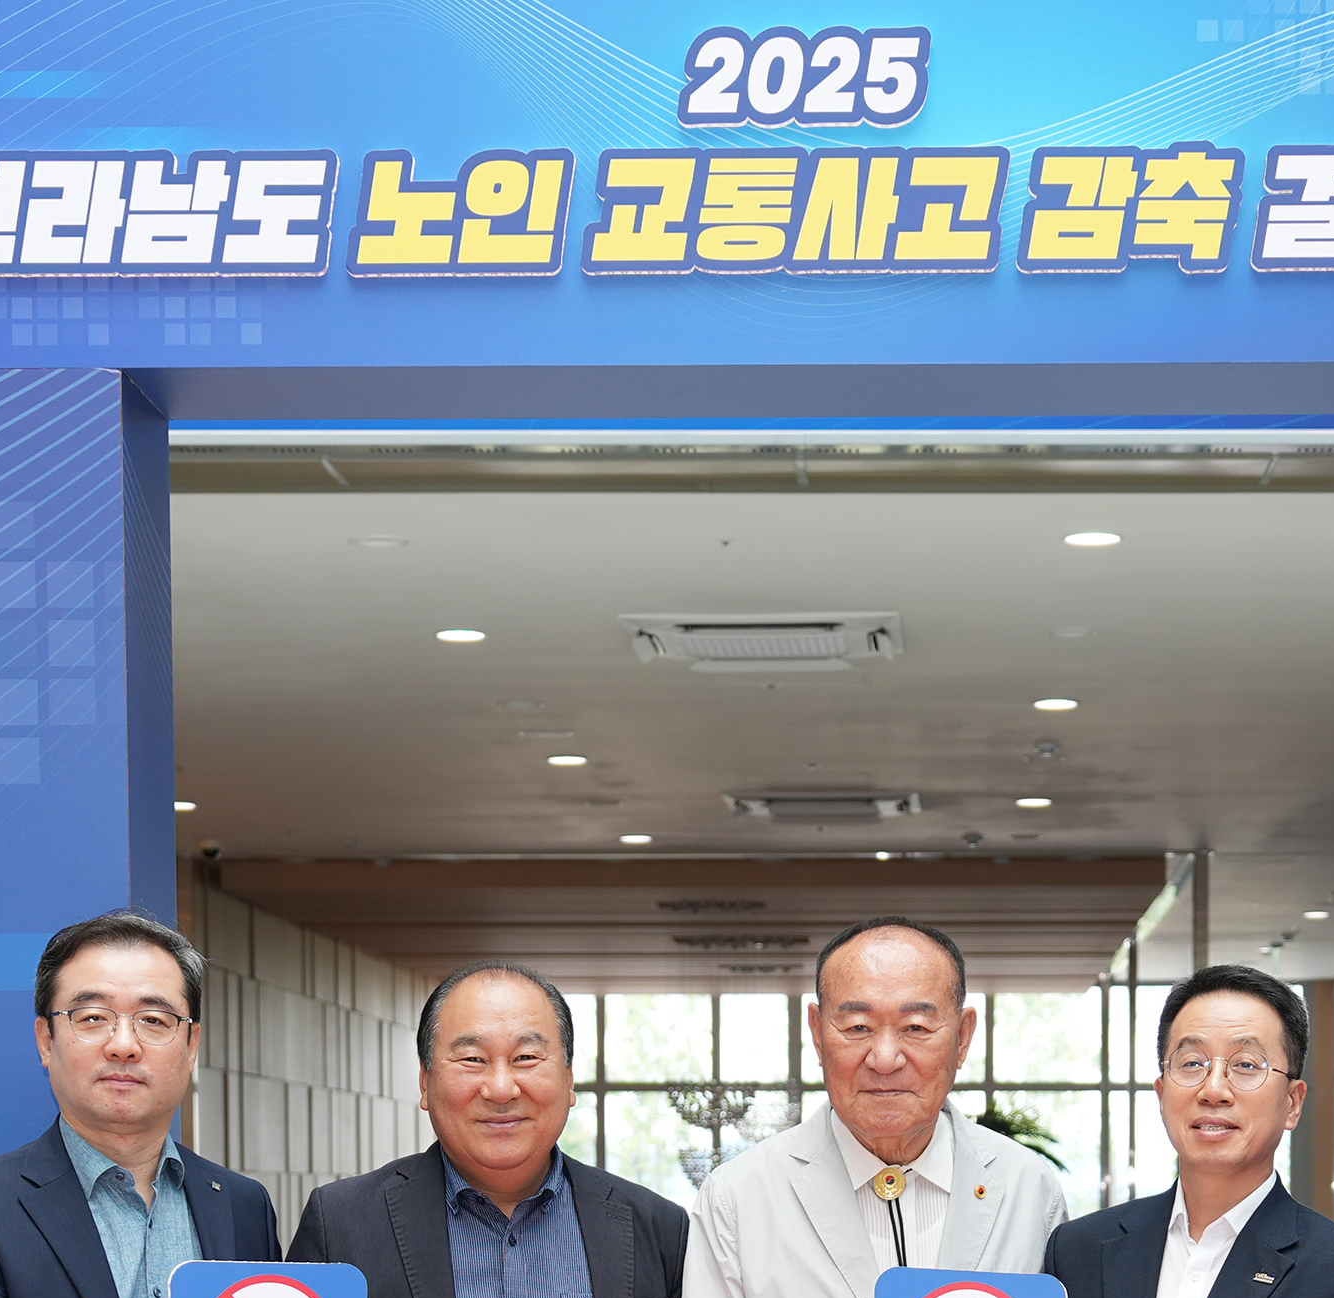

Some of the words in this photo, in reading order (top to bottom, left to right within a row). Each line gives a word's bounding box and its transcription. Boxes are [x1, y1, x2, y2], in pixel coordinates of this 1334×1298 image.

[685, 37, 924, 115] 2025
[354, 157, 567, 264] 노인
[589, 154, 1003, 262] 교통사고
[1026, 149, 1237, 261] 감축
